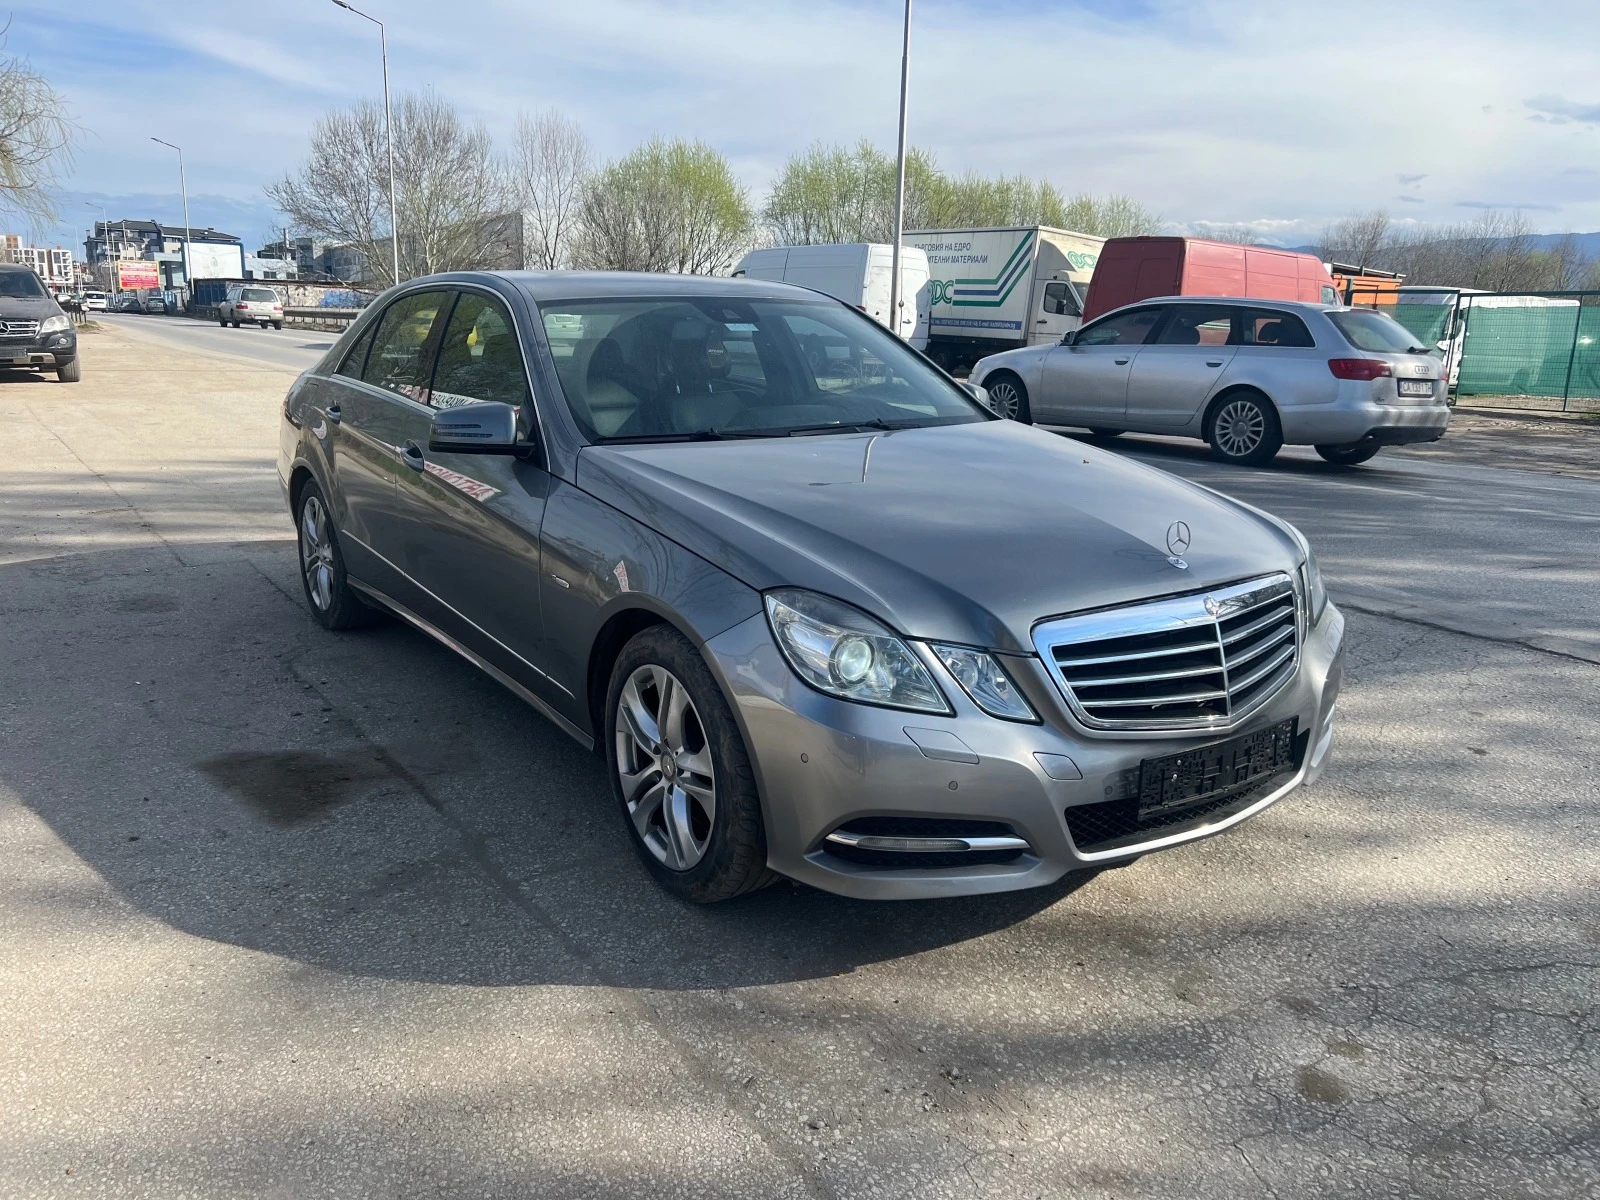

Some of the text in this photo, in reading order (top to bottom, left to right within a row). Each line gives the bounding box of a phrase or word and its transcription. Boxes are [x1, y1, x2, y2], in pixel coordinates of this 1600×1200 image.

[944, 243, 953, 252] НА
[954, 242, 971, 252] ЕДРО
[951, 254, 988, 264] МАТЕРИАЛИ
